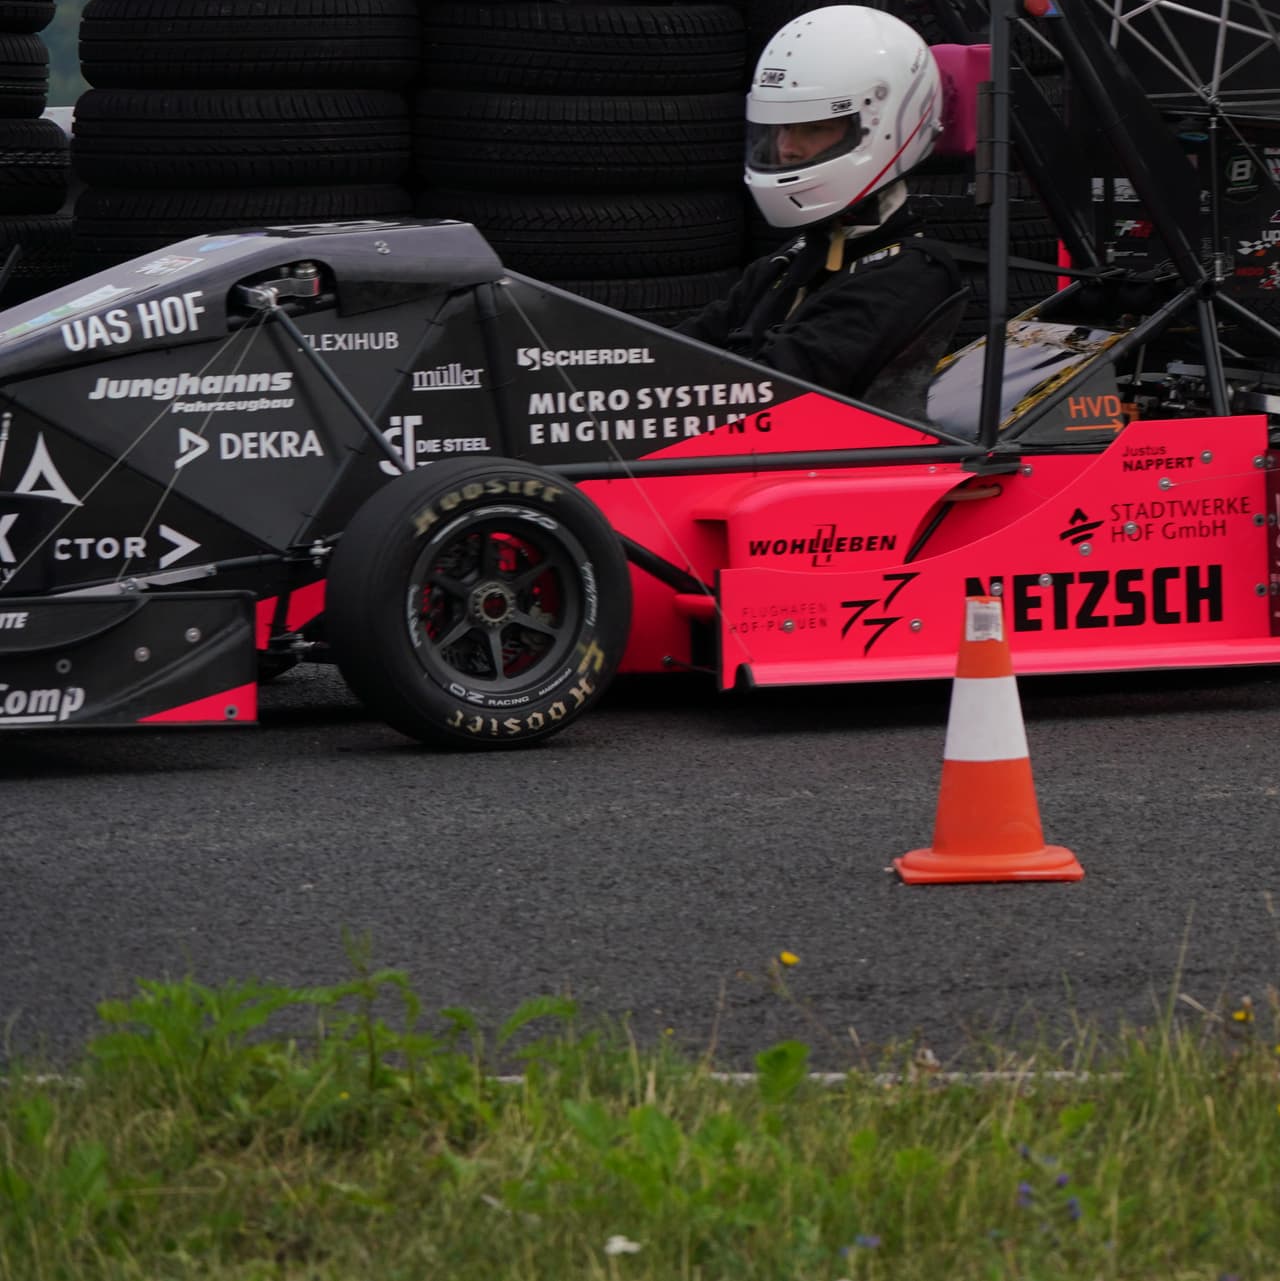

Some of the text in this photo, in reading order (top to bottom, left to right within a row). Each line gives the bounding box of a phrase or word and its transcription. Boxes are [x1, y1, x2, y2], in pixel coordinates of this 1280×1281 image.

[61, 308, 133, 352] UAS
[136, 290, 206, 339] HOF
[541, 348, 655, 367] SCHERDEL
[89, 372, 293, 401] Junghanns
[412, 363, 484, 388] müller
[171, 397, 294, 414] Fahrzeugbau
[529, 412, 772, 445] ENGINEERING
[220, 430, 323, 459] DEKRA
[1122, 445, 1167, 458] Justus
[1122, 456, 1194, 472] NAPPERT
[1110, 496, 1252, 522] STADTWERKE
[1111, 519, 1226, 543] HOF GmbH
[742, 602, 828, 618] FLUGHAFEN
[730, 617, 828, 634] HOF-PLUEN
